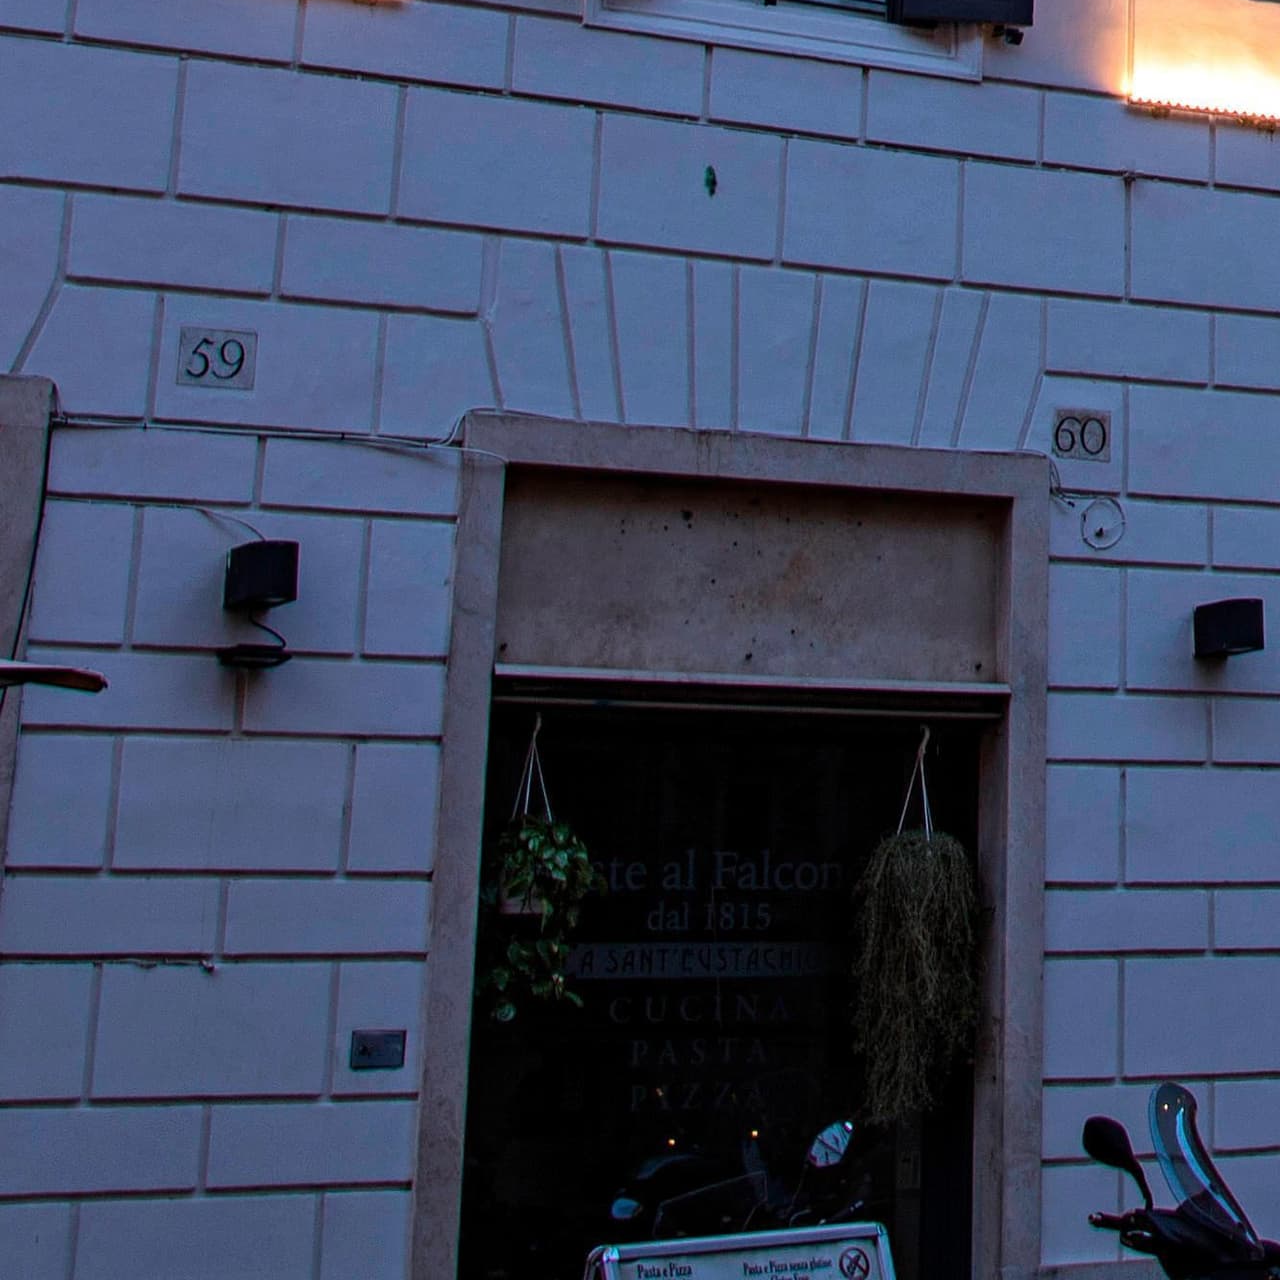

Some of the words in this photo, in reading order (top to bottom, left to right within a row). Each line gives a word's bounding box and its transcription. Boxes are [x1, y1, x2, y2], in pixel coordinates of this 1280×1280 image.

[186, 338, 245, 379] 59
[1055, 416, 1106, 455] 60
[661, 848, 697, 891] al
[646, 903, 689, 930] dal
[704, 903, 773, 931] 1815
[608, 994, 793, 1024] CUCINA
[627, 1037, 769, 1068] PASTA
[628, 1081, 769, 1113] PIZZA
[637, 1263, 661, 1279] Pasta
[669, 1262, 692, 1277] Pizza
